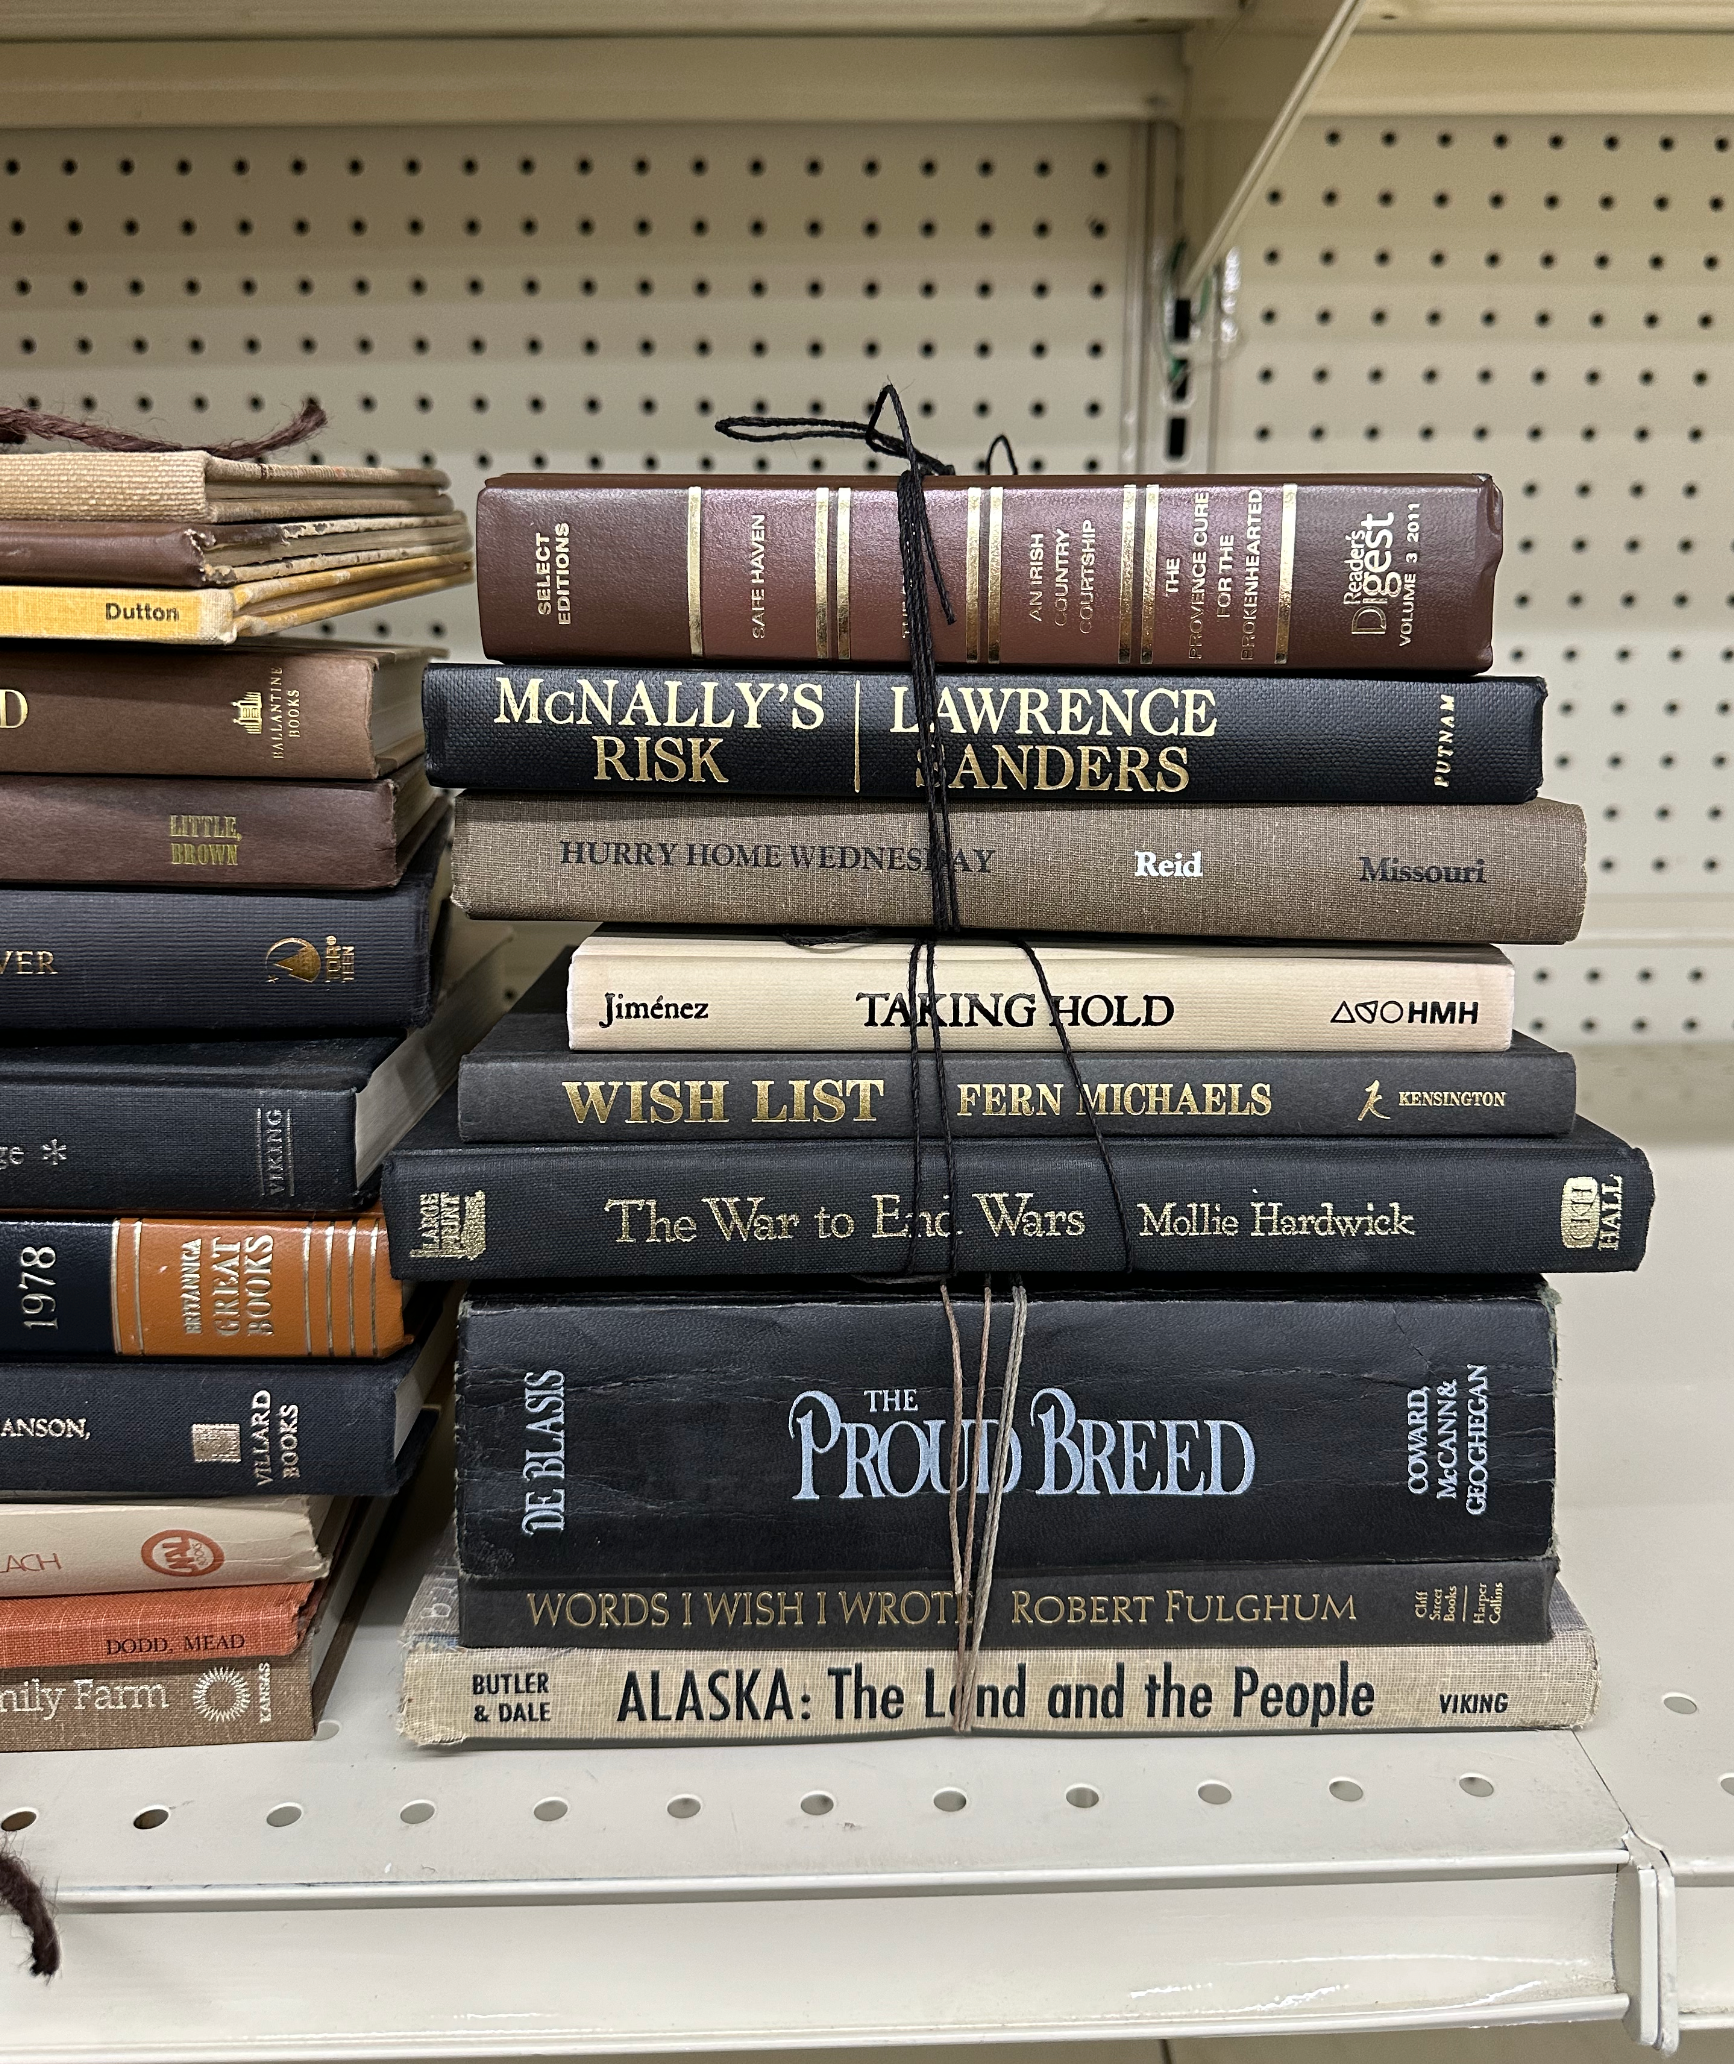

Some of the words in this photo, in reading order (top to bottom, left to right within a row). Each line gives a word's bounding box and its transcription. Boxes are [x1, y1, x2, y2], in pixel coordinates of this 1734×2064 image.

[1193, 491, 1209, 547] CURE
[1407, 503, 1420, 543] 2011
[752, 514, 766, 584] HAVEN
[1030, 533, 1044, 585] IRISH
[1219, 534, 1234, 574] THE
[1343, 530, 1365, 605] Reader's
[1406, 552, 1418, 563] 3
[536, 533, 552, 615] SELECT
[558, 522, 572, 625] EDITIONS
[1054, 528, 1070, 626] COUNTRY
[1079, 520, 1096, 635] COURTSHIP
[1165, 557, 1180, 597] THE
[1217, 577, 1232, 618] FOR
[1241, 489, 1262, 661] BROKENHEARTED
[1351, 512, 1402, 635] Digest
[105, 602, 180, 622] Dutton
[752, 587, 766, 639] SAFE
[1029, 590, 1043, 622] AN
[1189, 552, 1208, 660] PROVENCE
[1399, 573, 1416, 647] VOLUME
[271, 666, 283, 760] BALLANTINE
[288, 689, 300, 738] BOOKS
[494, 676, 824, 731] McNALLY'S
[889, 686, 1217, 739] LAWRENCE
[592, 735, 729, 783] RISK
[1433, 693, 1455, 788] PUTNAM
[170, 814, 242, 842] LITTLE,
[171, 844, 239, 867] BROWN
[559, 840, 678, 866] HURRY
[687, 842, 784, 868] HOME
[1134, 849, 1203, 878] Reid
[1358, 856, 1487, 885] Missouri
[599, 992, 709, 1028] Jiménez
[856, 992, 1037, 1029] TAKING
[1048, 994, 1175, 1028] HOLD
[1408, 1003, 1479, 1025] HMH
[561, 1079, 729, 1124] WISH
[752, 1078, 885, 1123] LIST
[957, 1082, 1064, 1117] FERN
[1076, 1081, 1273, 1117] MICHAELS
[1398, 1090, 1506, 1108] KENSINGTON
[266, 1109, 285, 1197] VIKING
[440, 1191, 461, 1249] PRINT
[604, 1195, 697, 1244] The
[699, 1197, 800, 1243] War
[814, 1200, 855, 1239] to
[972, 1192, 1086, 1238] Wars
[1137, 1198, 1239, 1239] Mollie
[1250, 1197, 1416, 1238] Hardwick
[1598, 1173, 1622, 1251] HALL
[18, 1245, 58, 1331] 1978
[180, 1237, 203, 1335] BRITANNICA
[211, 1236, 241, 1337] GREAT
[244, 1234, 275, 1337] BOOKS
[864, 1388, 918, 1413] THE
[0, 1418, 91, 1440] ANSON,
[252, 1390, 273, 1486] VILLARD
[280, 1404, 300, 1479] BOOKS
[523, 1369, 565, 1482] BLASIS
[788, 1390, 1021, 1501] PROUD
[1030, 1388, 1256, 1497] BREED
[1407, 1386, 1430, 1496] COWARD,
[1466, 1364, 1488, 1516] GEOGHEGAN
[1436, 1401, 1457, 1500] McCANN
[521, 1489, 565, 1536] DE
[526, 1590, 670, 1628] WORDS
[682, 1592, 694, 1626] I
[704, 1591, 803, 1627] WISH
[816, 1592, 828, 1626] I
[1011, 1590, 1156, 1626] ROBERT
[1164, 1588, 1358, 1624] FULGHUM
[1415, 1590, 1428, 1618] Cliff
[1428, 1588, 1442, 1621] Street
[1443, 1585, 1457, 1622] Books
[1473, 1582, 1490, 1624] Harper
[1489, 1581, 1504, 1624] Collins
[106, 1637, 174, 1656] DODD,
[184, 1634, 246, 1652] MEAD
[73, 1677, 170, 1710] Farm
[258, 1661, 271, 1723] KANSAS
[472, 1672, 549, 1696] BUTLER
[617, 1667, 812, 1722] ALASKA:
[827, 1662, 905, 1721] The
[1048, 1661, 1125, 1719] and
[1144, 1661, 1213, 1719] the
[1233, 1659, 1375, 1728] People
[1439, 1693, 1509, 1716] VIKING
[474, 1703, 489, 1723] &
[498, 1702, 551, 1723] DALE
